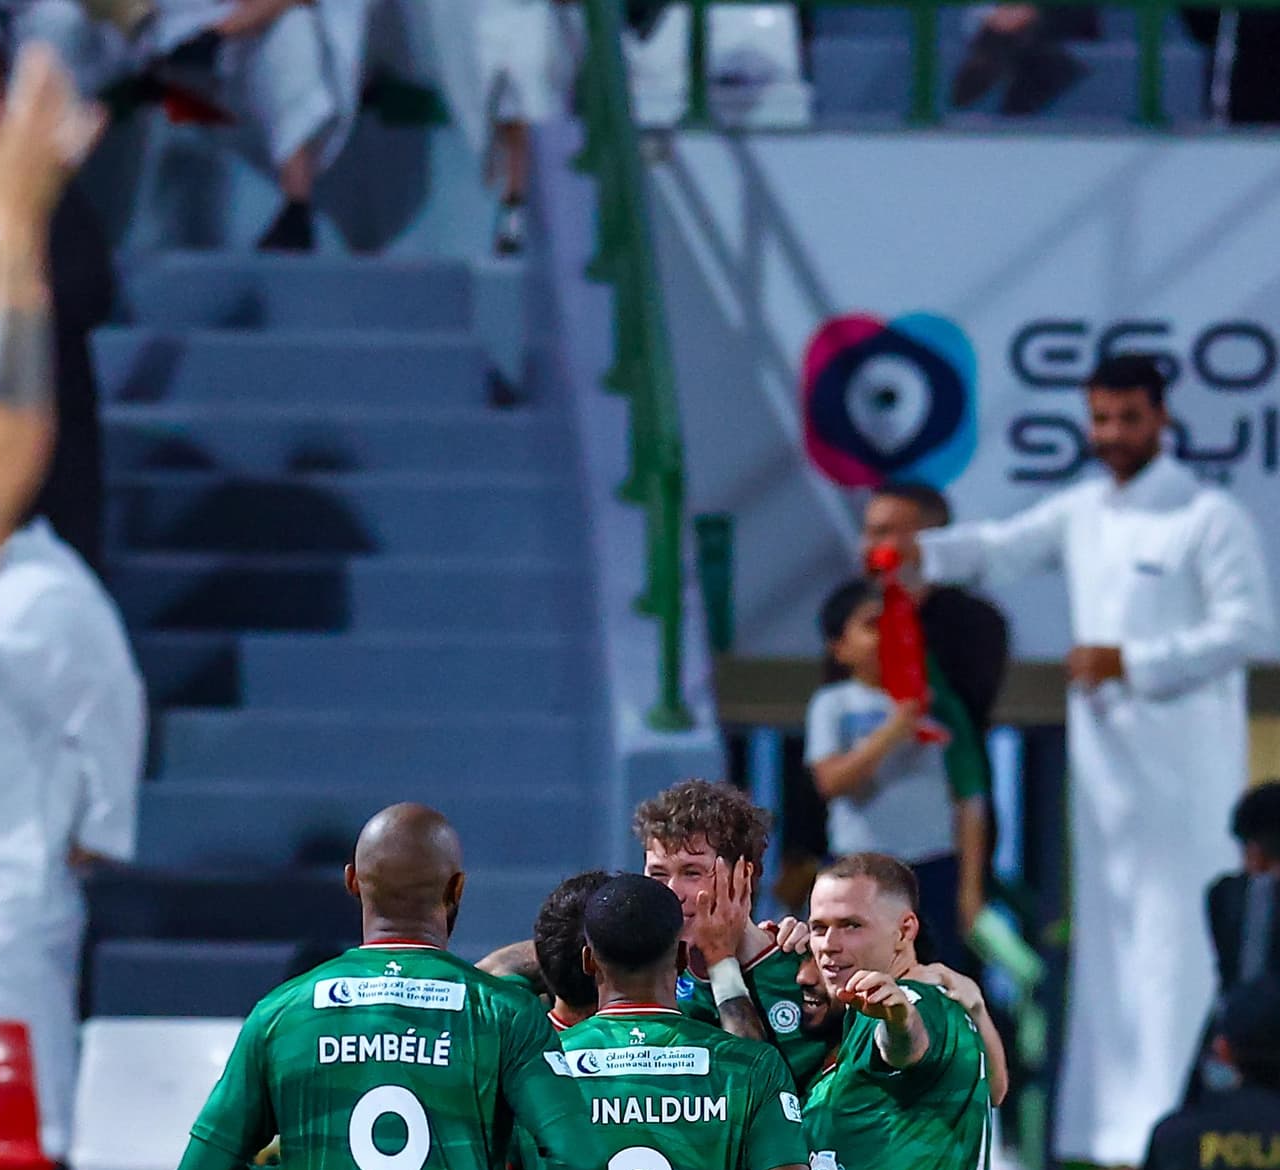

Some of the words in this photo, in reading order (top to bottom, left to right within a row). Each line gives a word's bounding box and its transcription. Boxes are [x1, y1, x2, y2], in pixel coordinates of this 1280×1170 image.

[319, 1028, 451, 1066] DEMBÉLÉ
[654, 1060, 695, 1069] Hospital
[592, 1096, 727, 1125] JNALDUM
